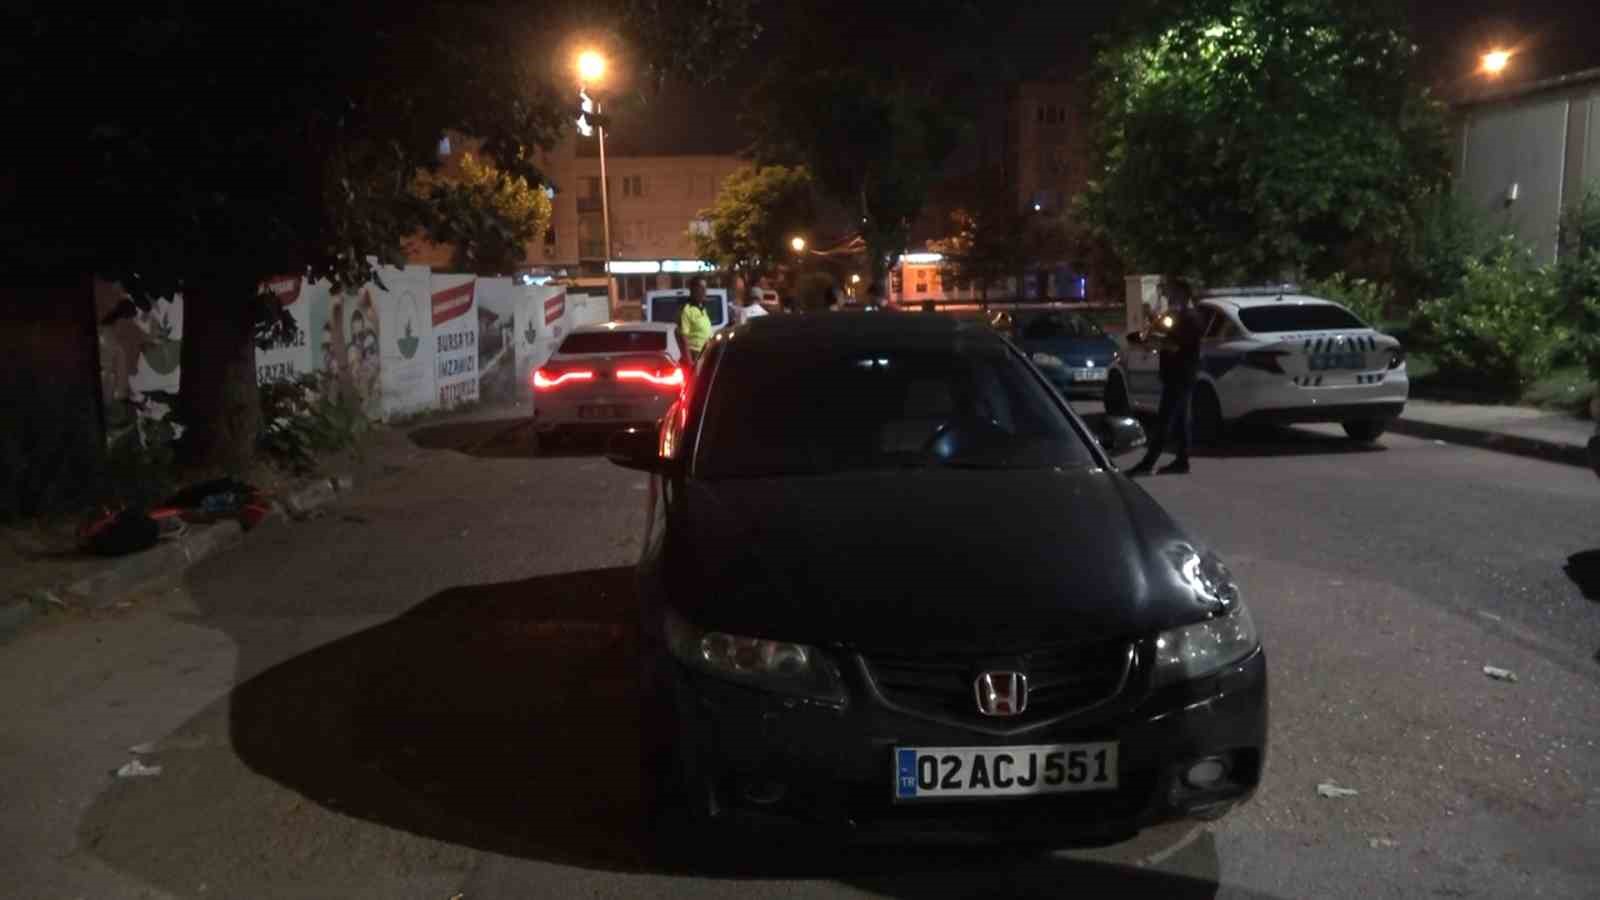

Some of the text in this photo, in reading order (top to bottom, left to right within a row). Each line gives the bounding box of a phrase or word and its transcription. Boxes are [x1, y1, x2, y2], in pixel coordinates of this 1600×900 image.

[901, 749, 1108, 790] TR 02 ACJ 551
